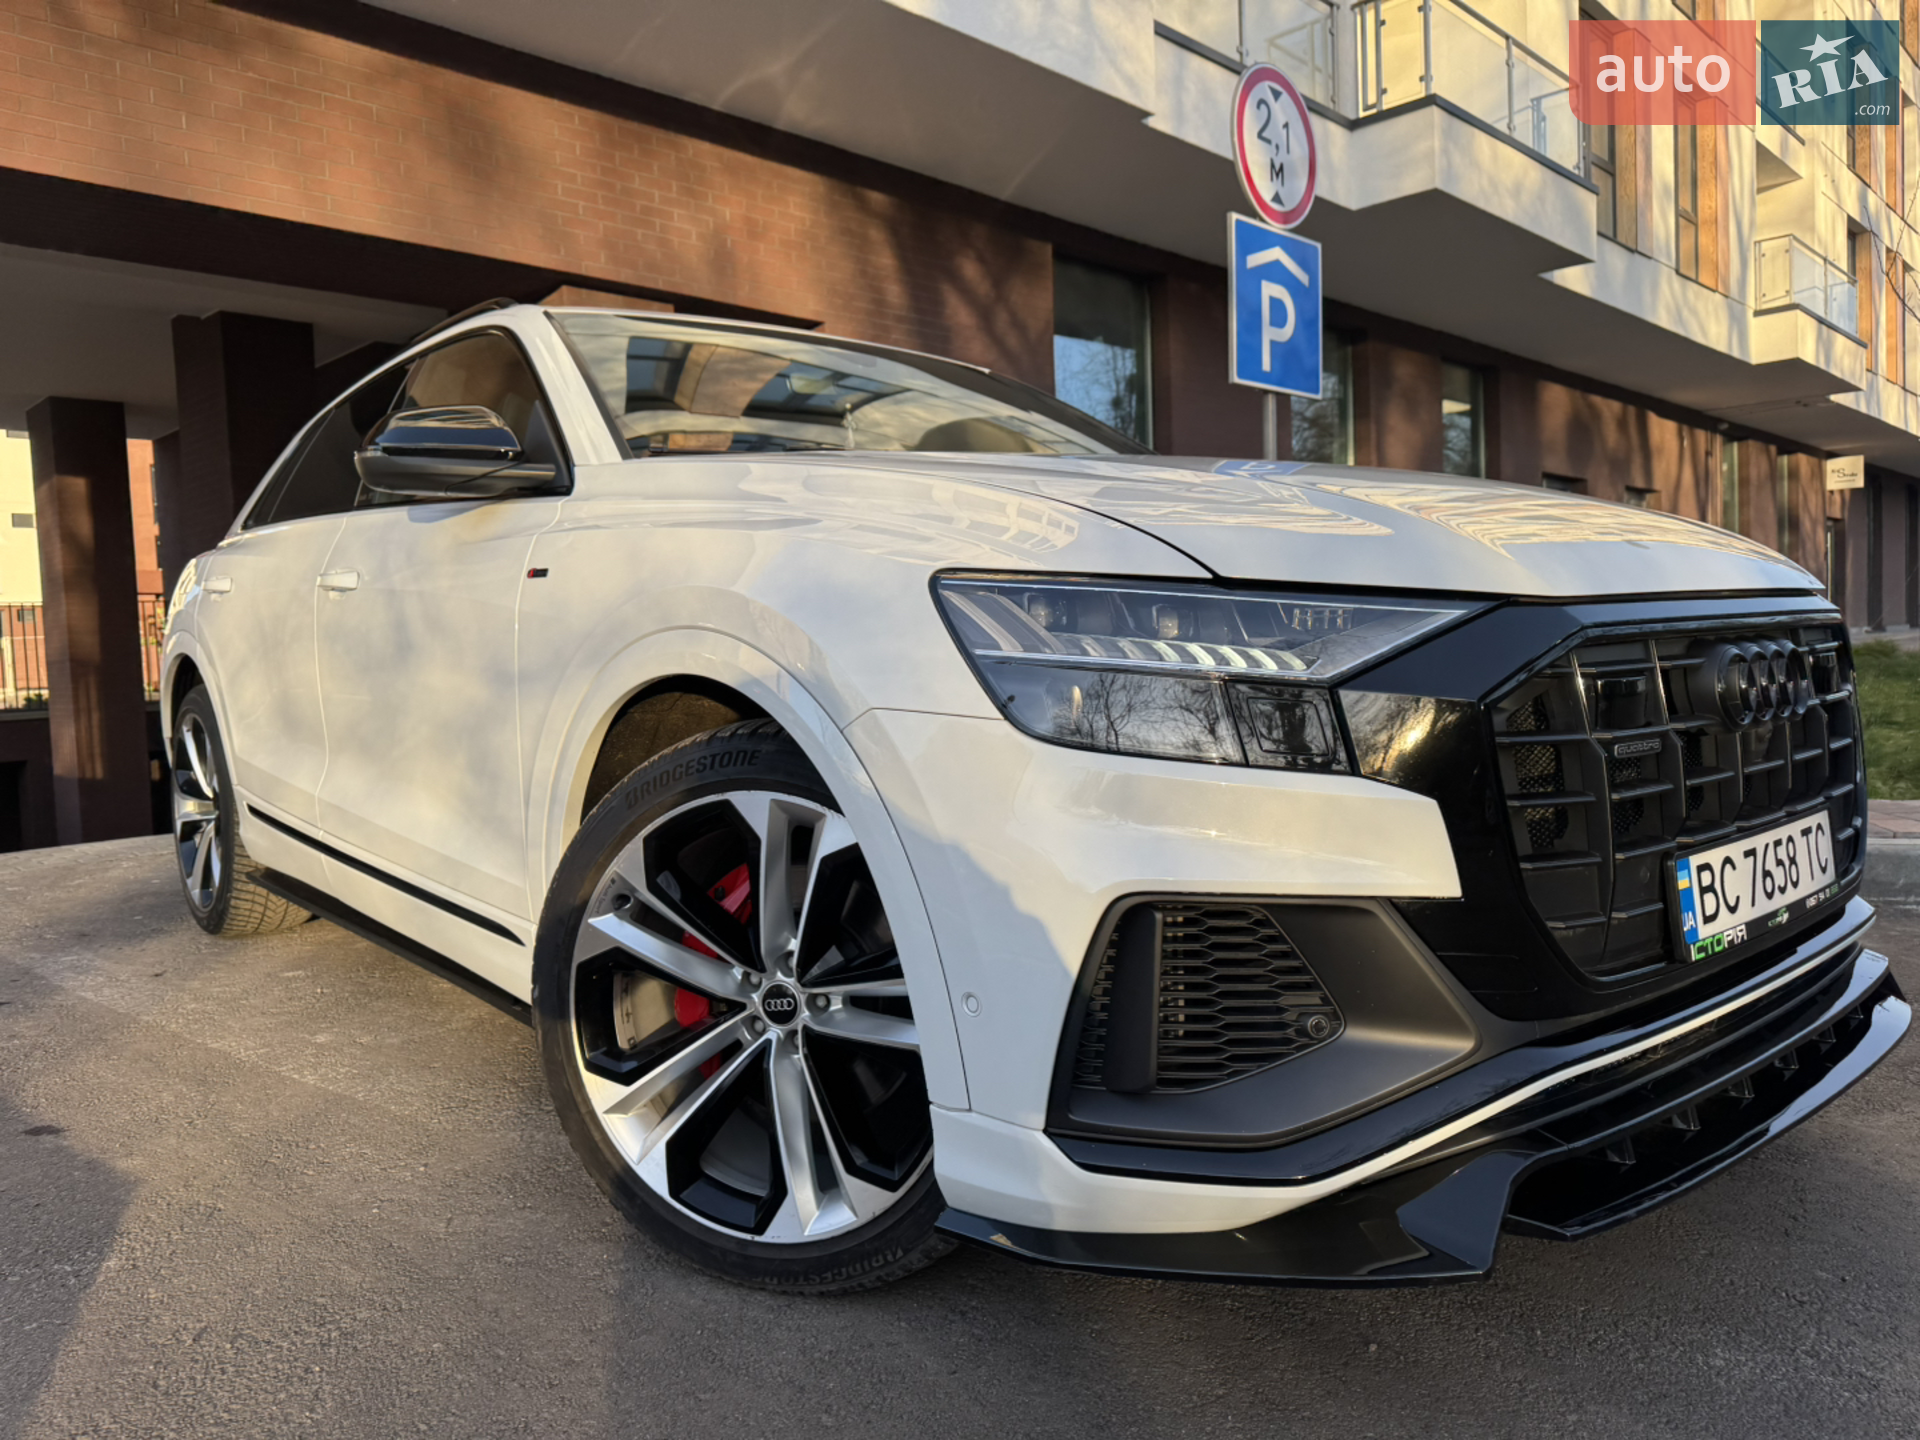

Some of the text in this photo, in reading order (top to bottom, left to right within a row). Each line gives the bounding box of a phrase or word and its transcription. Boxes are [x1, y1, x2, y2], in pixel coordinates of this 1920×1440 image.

[1256, 97, 1290, 156] 2,1
[1261, 279, 1296, 373] P
[1618, 741, 1660, 755] quattro
[624, 749, 762, 810] BRIDGESTONE
[1696, 822, 1828, 926] BC 7658 TC
[1683, 911, 1696, 931] UA
